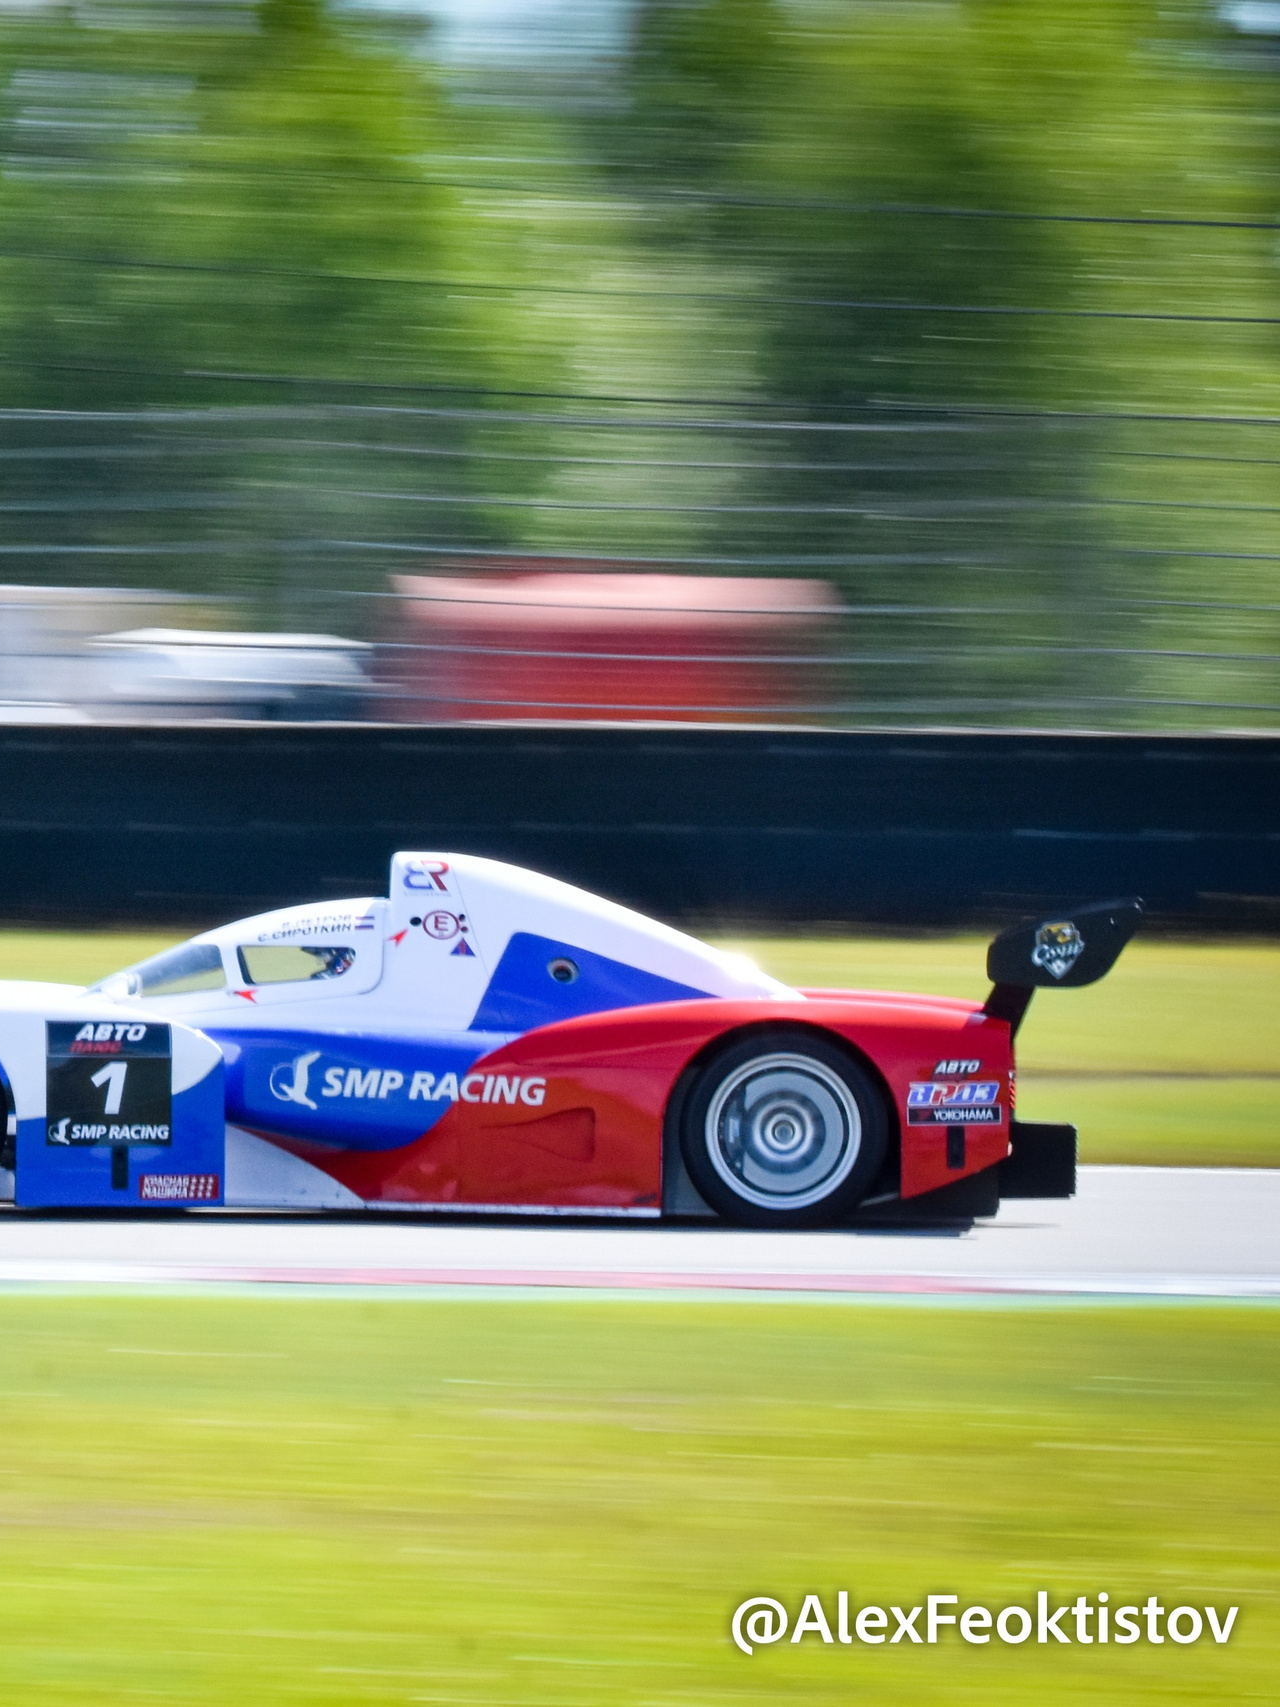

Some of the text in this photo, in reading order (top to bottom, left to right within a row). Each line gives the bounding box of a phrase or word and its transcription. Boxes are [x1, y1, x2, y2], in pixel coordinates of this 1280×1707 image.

[434, 915, 449, 931] E
[75, 1023, 147, 1041] АВТО
[935, 1060, 981, 1074] АВТО
[91, 1061, 128, 1115] 1
[322, 1066, 547, 1106] SMP RACING
[933, 1108, 994, 1121] YOKOHAMA
[71, 1124, 170, 1140] SMP RACING
